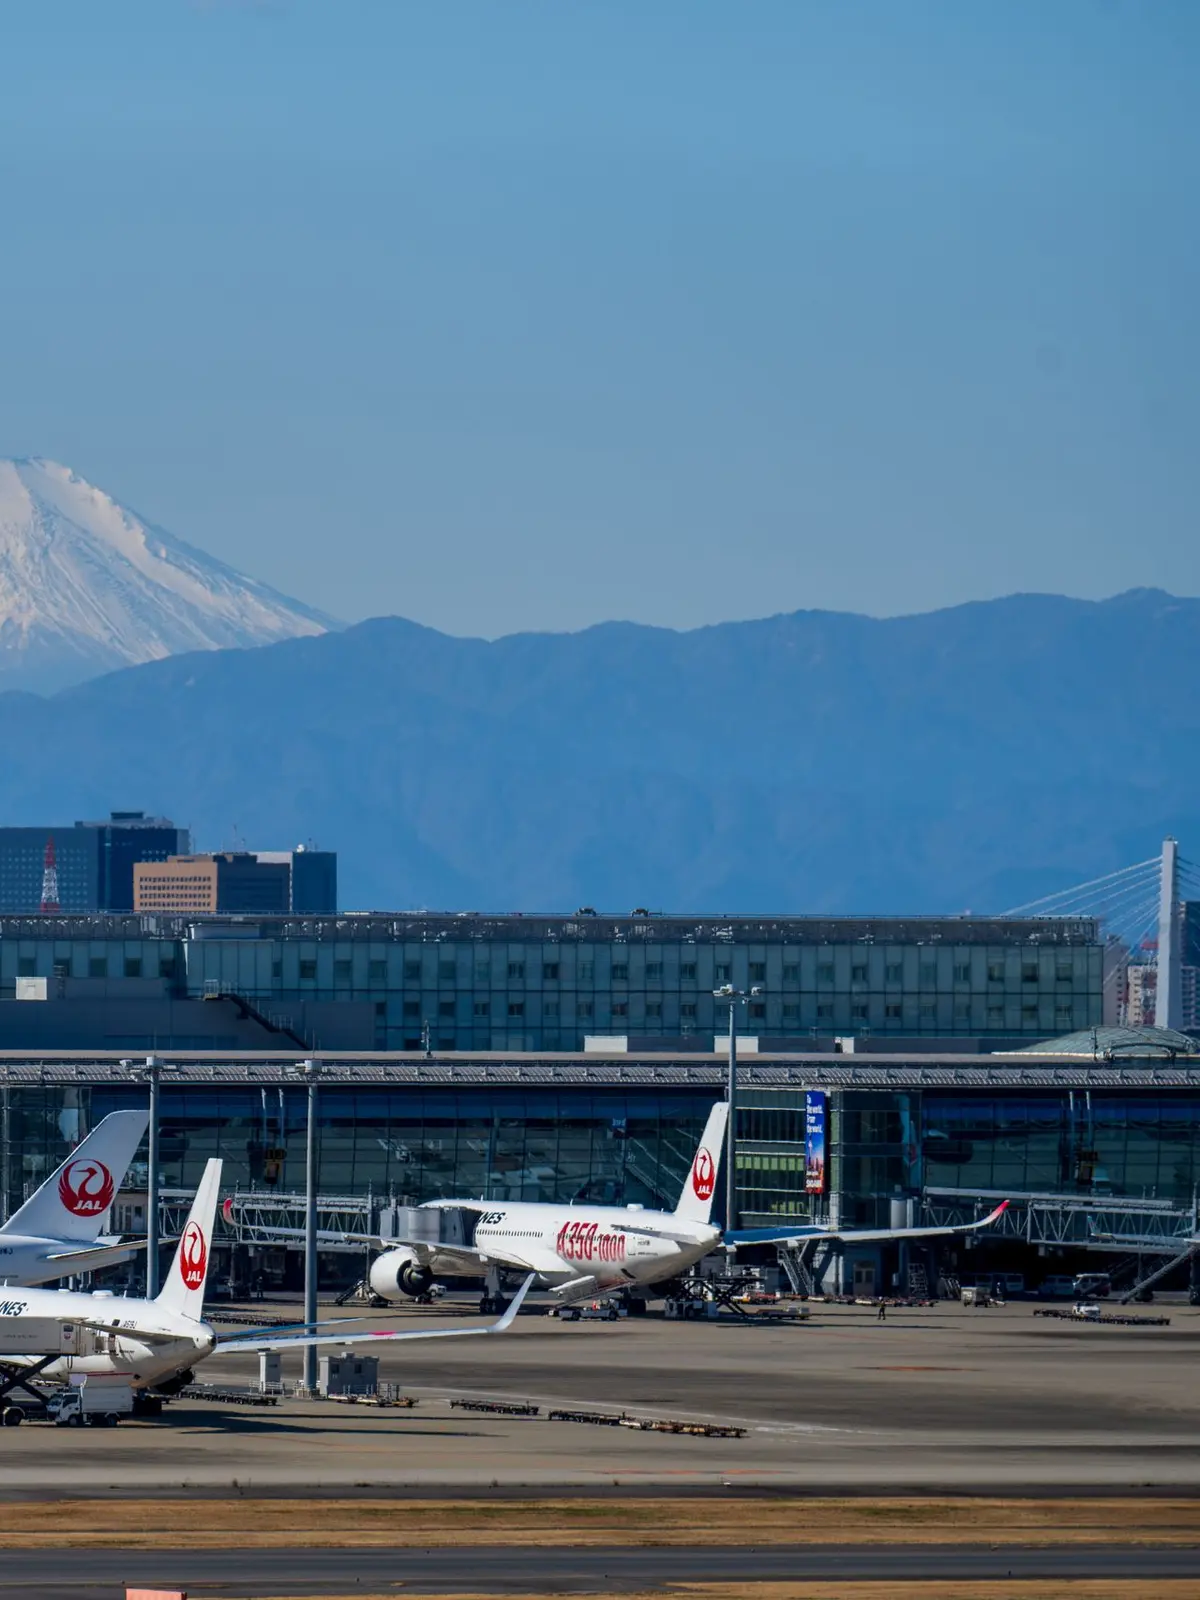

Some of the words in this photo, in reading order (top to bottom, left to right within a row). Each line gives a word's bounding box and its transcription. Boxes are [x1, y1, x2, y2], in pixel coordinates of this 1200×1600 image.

[697, 1184, 711, 1195] JAL
[73, 1200, 103, 1210] JAL
[556, 1221, 626, 1262] A350-1000
[186, 1270, 202, 1282] JAL
